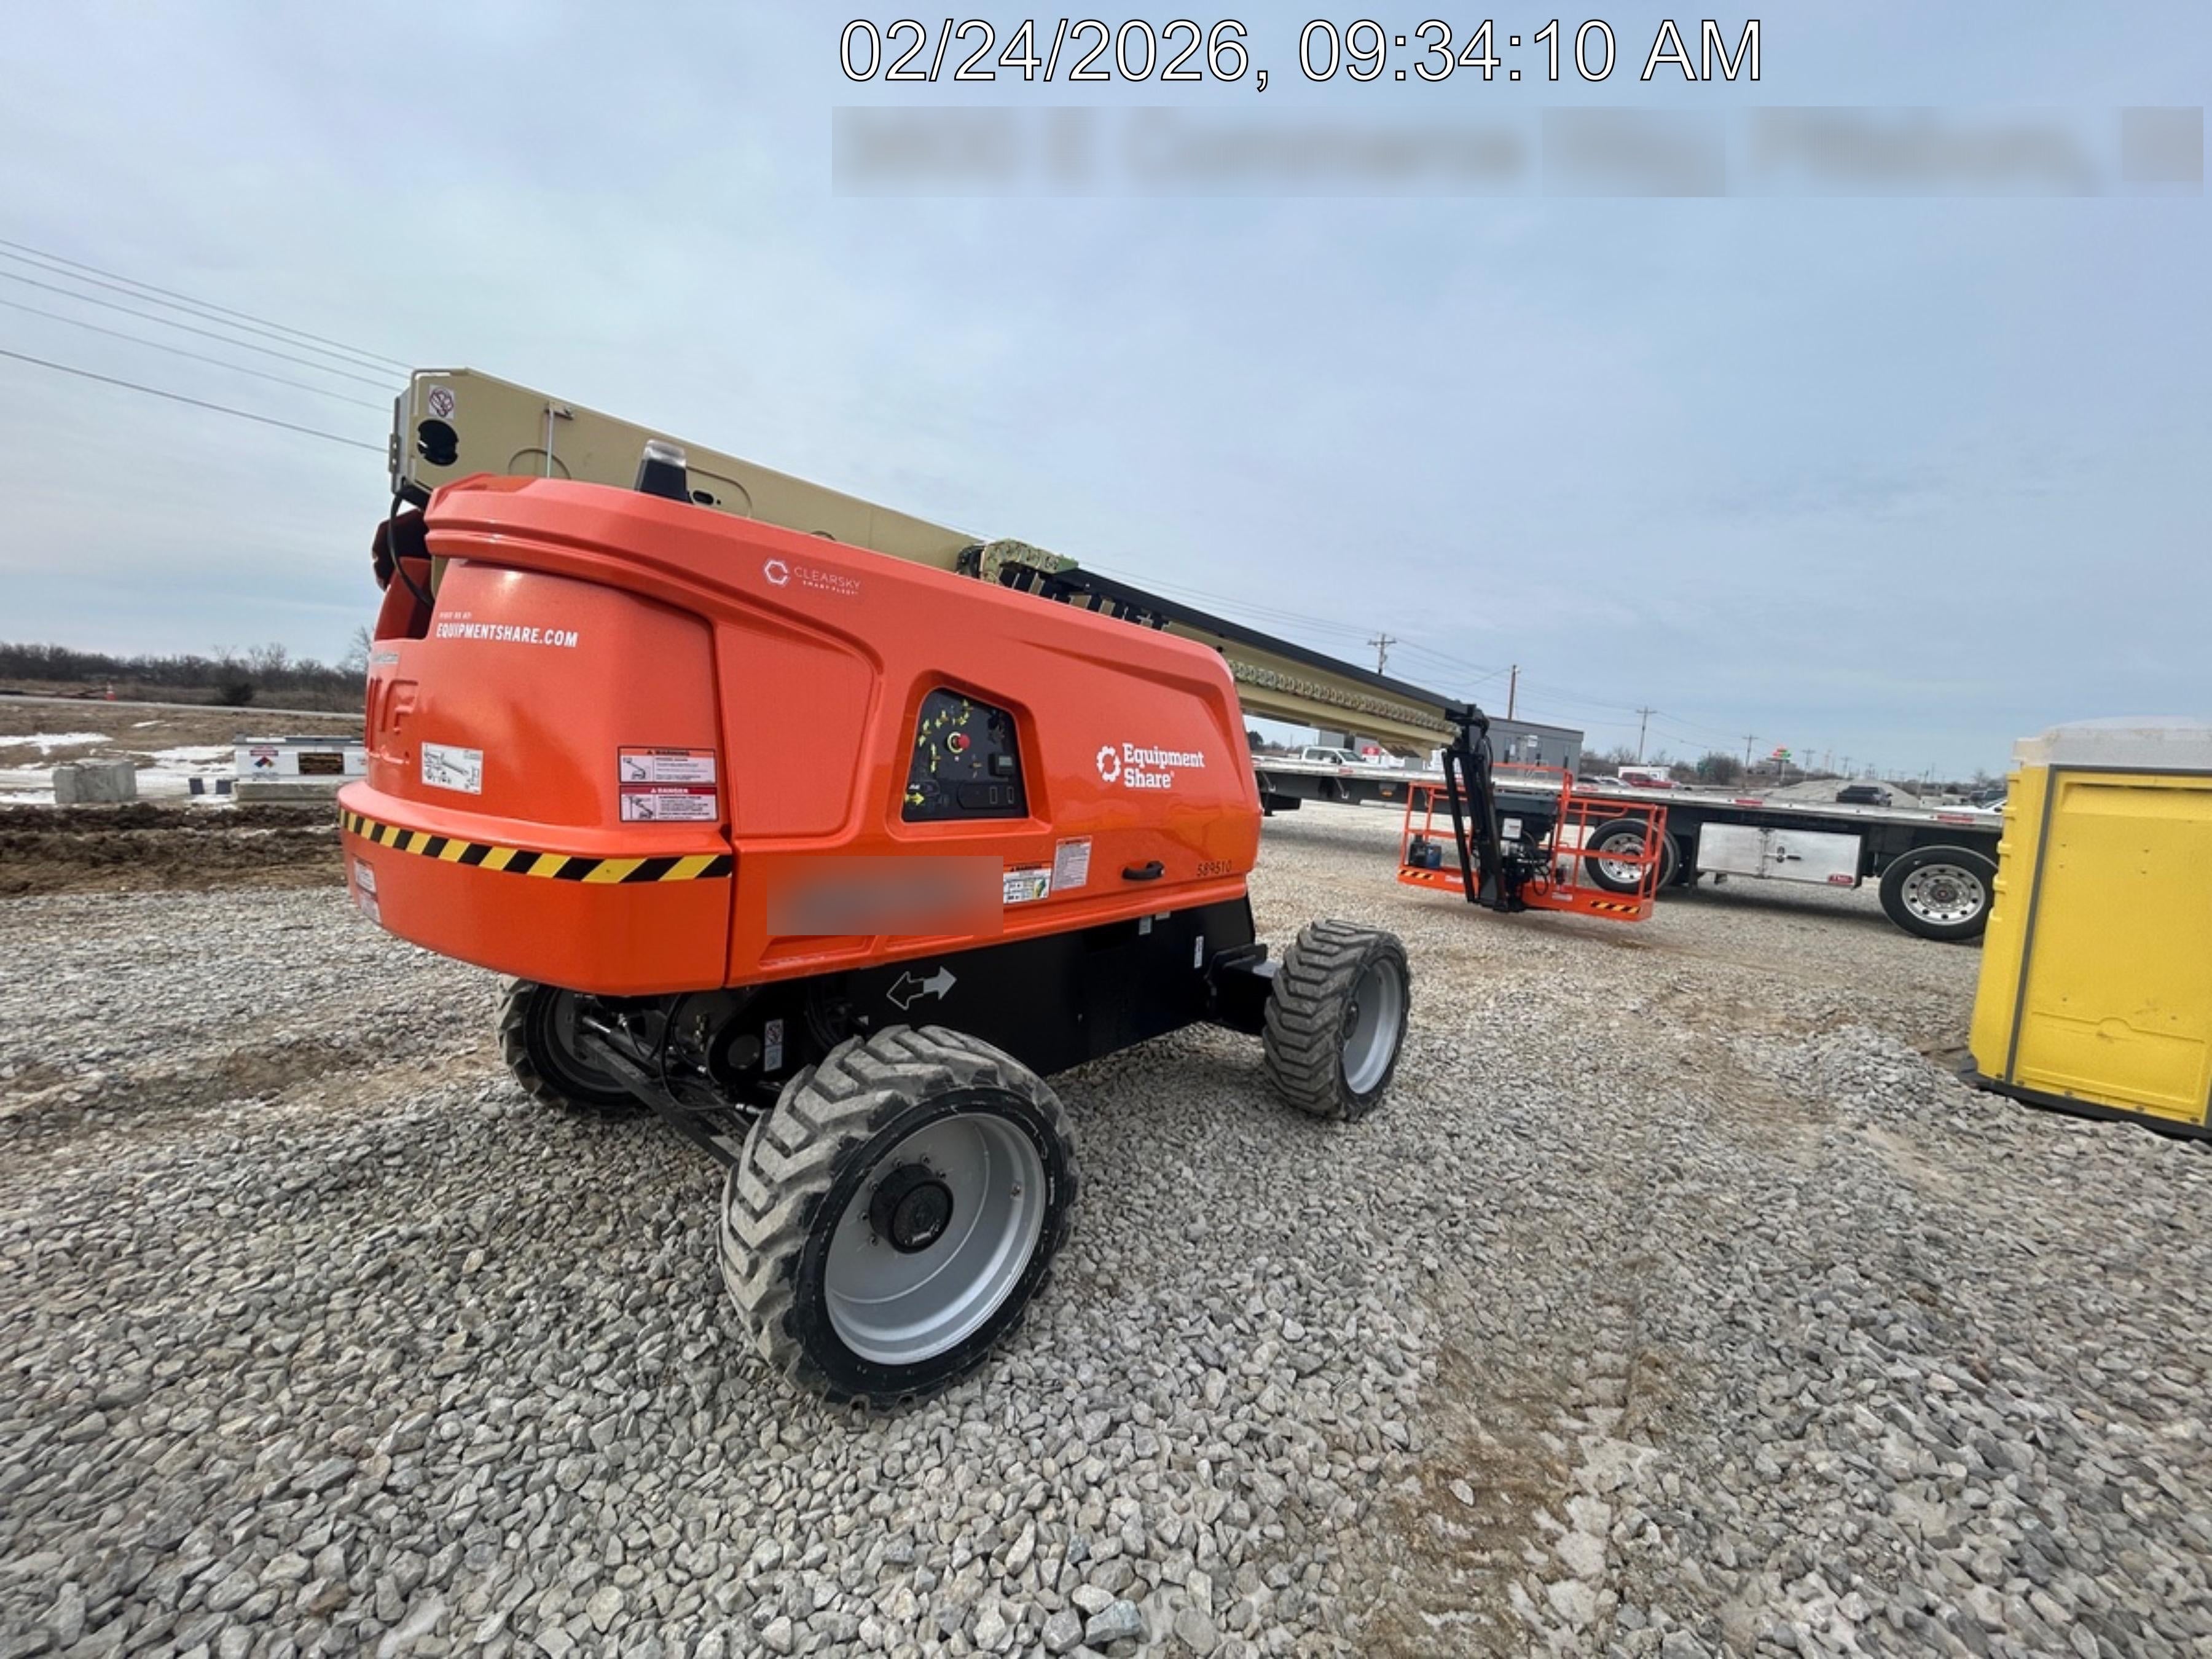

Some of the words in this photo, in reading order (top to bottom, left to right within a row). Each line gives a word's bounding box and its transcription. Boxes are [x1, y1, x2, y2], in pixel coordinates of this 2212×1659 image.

[794, 567, 860, 589] CLEARSKY
[437, 622, 579, 648] EQUIPMENTSHARE.COM
[1122, 742, 1206, 769] Equipment
[1124, 767, 1171, 788] Share
